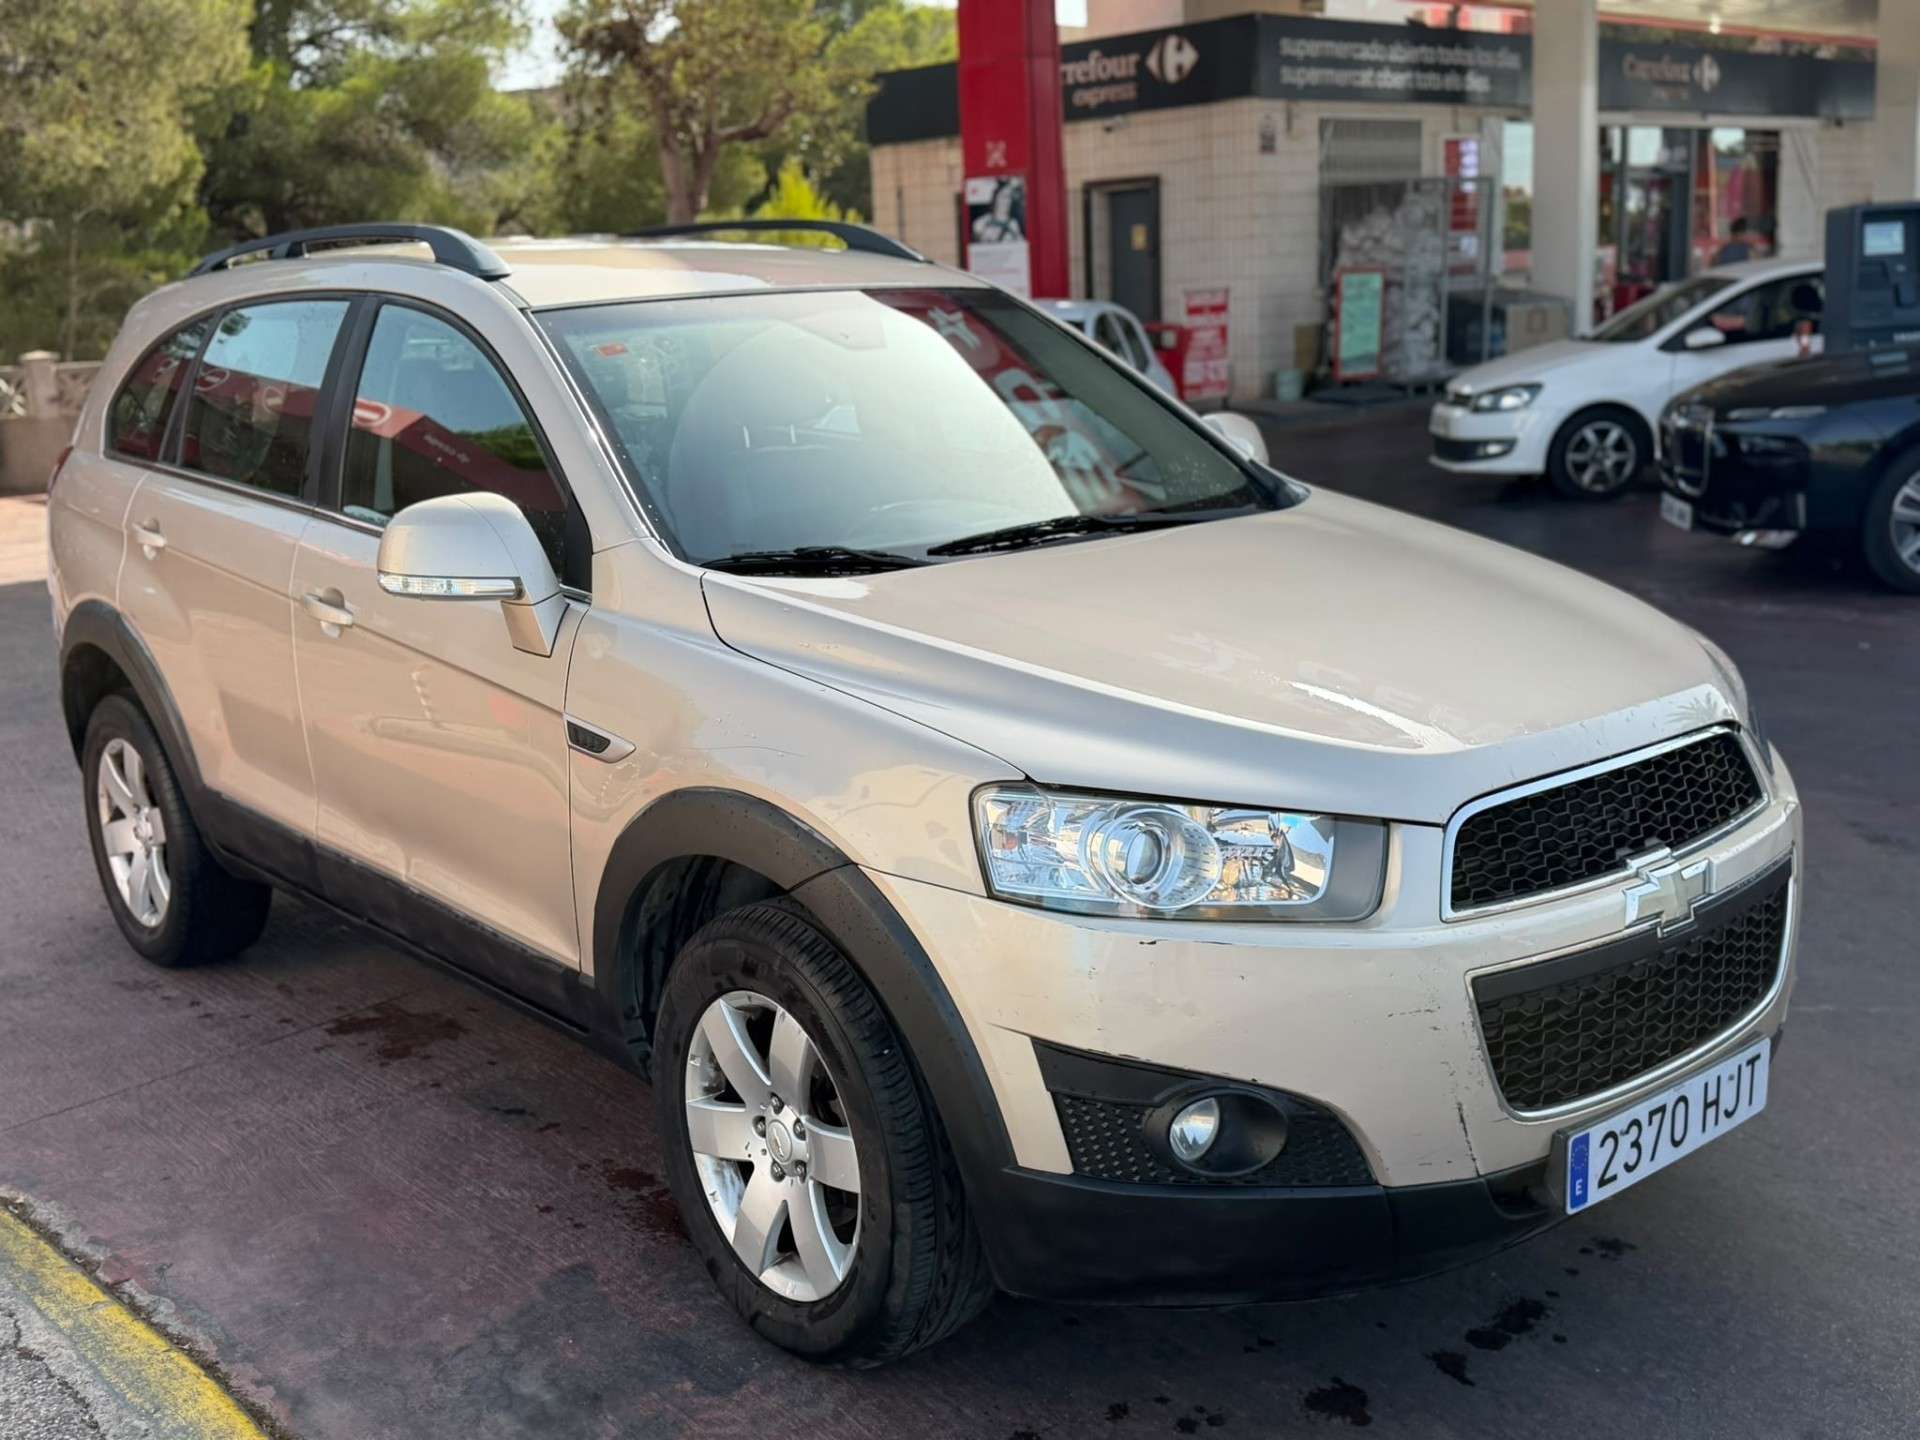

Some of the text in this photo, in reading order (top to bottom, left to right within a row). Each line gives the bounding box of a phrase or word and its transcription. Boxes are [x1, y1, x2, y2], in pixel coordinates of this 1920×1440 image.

[1597, 1053, 1761, 1189] 2370 HJT
[1575, 1178, 1583, 1196] E
